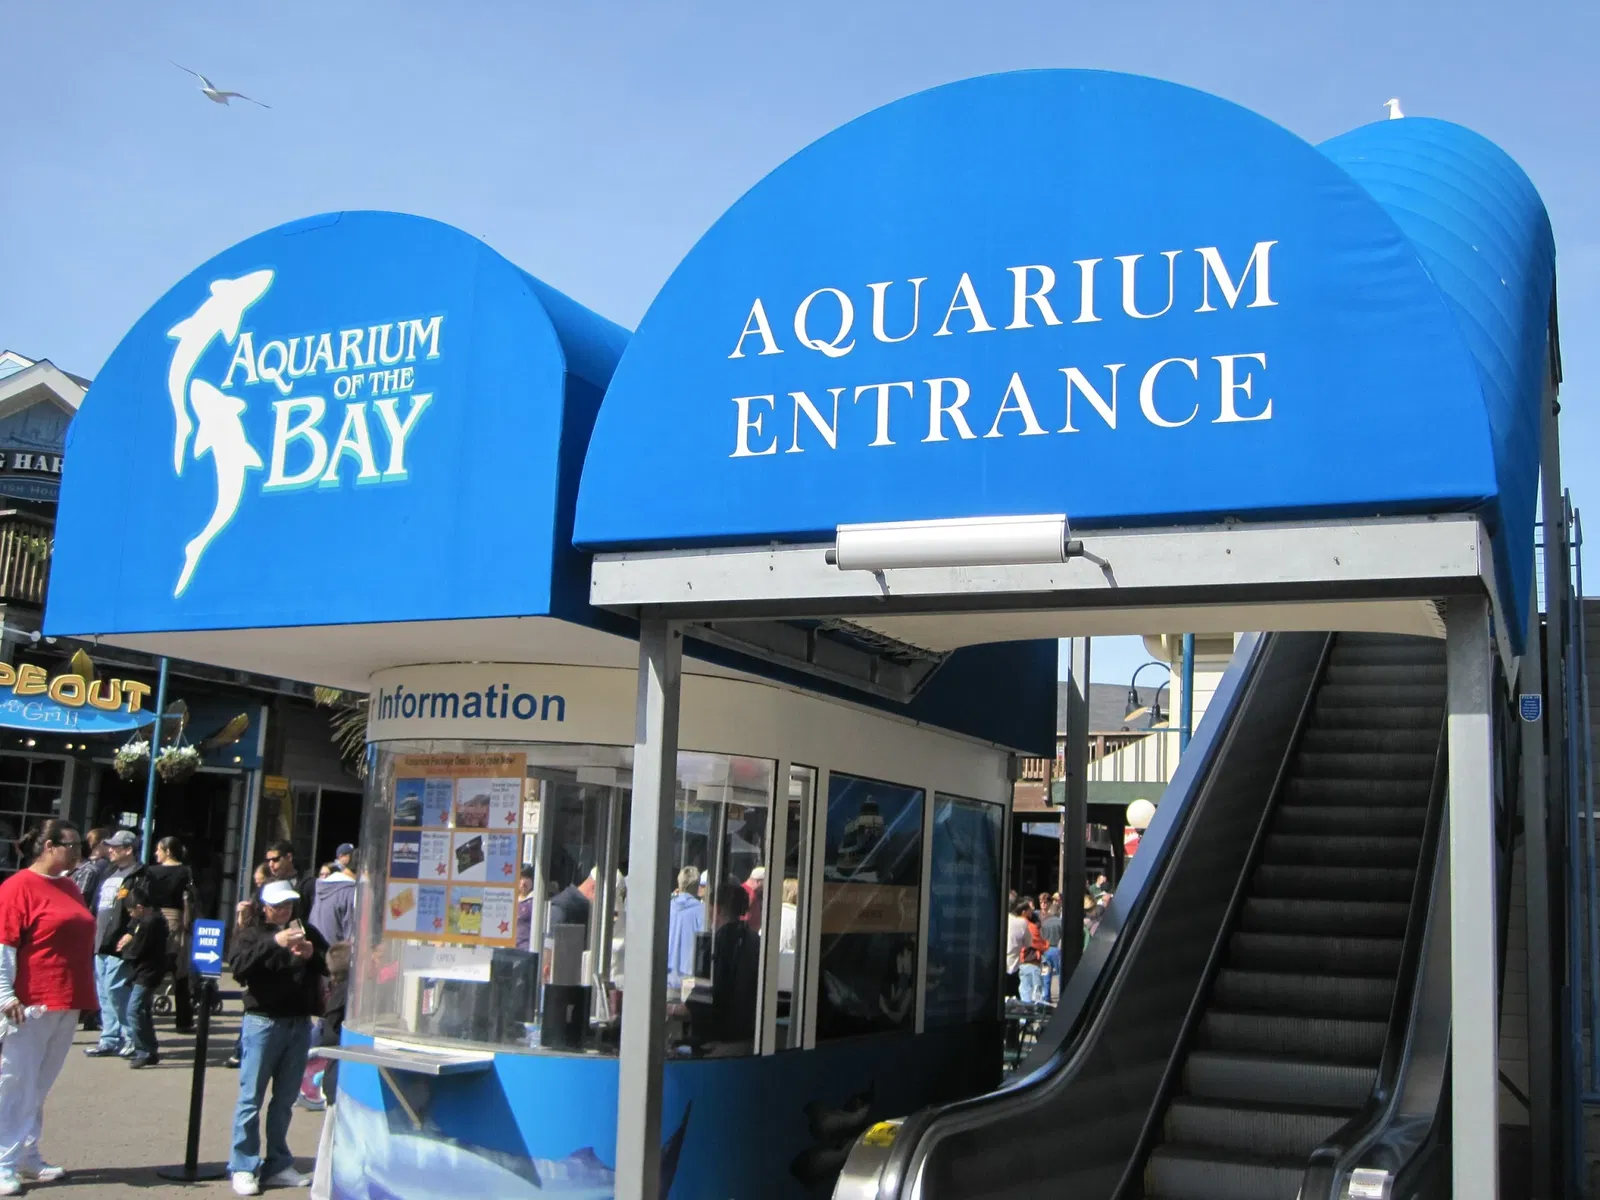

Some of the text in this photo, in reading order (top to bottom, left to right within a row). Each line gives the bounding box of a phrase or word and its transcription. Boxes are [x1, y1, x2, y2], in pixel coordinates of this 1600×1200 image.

[727, 240, 1279, 359] AQUARIUM
[220, 315, 444, 395] AQUARIUM
[333, 366, 415, 399] OF THE
[728, 352, 1273, 458] ENTRANCE
[262, 391, 434, 492] BAY
[378, 683, 566, 722] Information
[198, 926, 221, 936] ENTER
[199, 937, 219, 946] HERE
